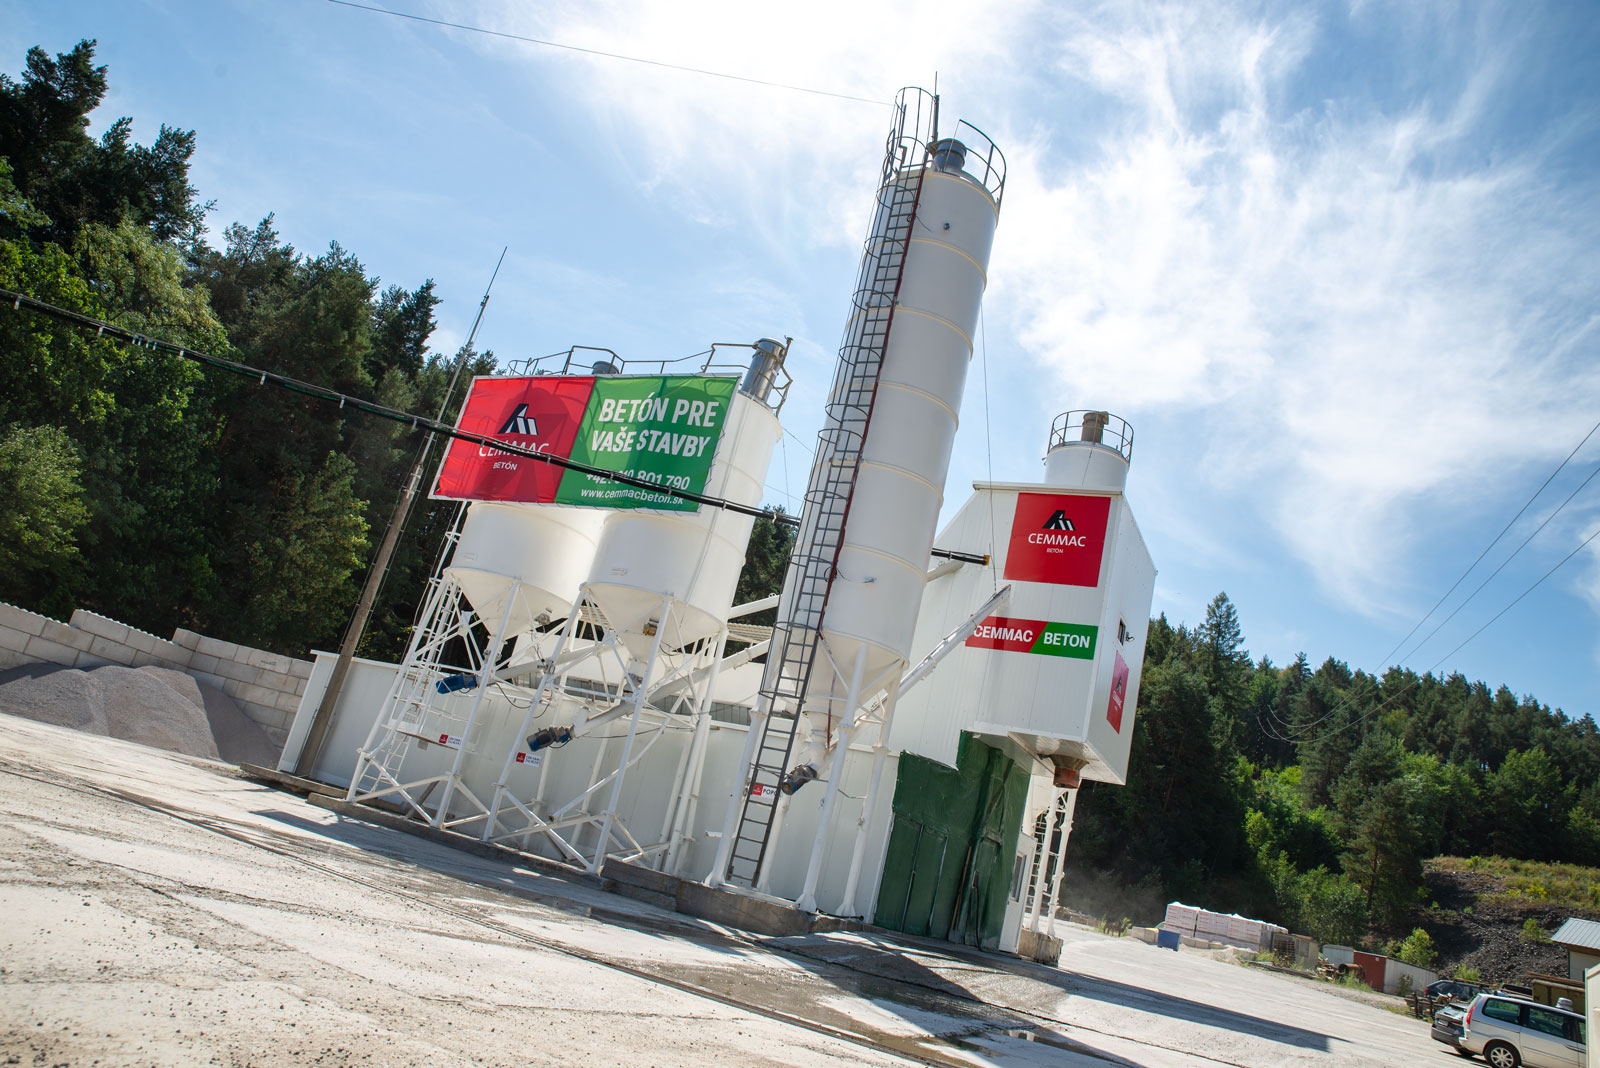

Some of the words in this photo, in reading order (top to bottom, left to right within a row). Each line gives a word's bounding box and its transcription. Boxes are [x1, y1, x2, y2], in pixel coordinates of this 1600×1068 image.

[598, 392, 670, 423] BETÓN
[672, 398, 719, 427] PRE
[592, 426, 637, 452] VAŠE
[636, 429, 711, 457] STAVBY
[493, 461, 518, 471] BETÓN
[637, 470, 662, 487] 801
[664, 475, 690, 490] 790
[581, 488, 683, 504] www.cemmacbeton.sk
[1027, 533, 1086, 547] CEMMAC
[973, 625, 1033, 643] CEMMAC
[1043, 632, 1090, 648] BETON
[763, 788, 777, 796] POPO
